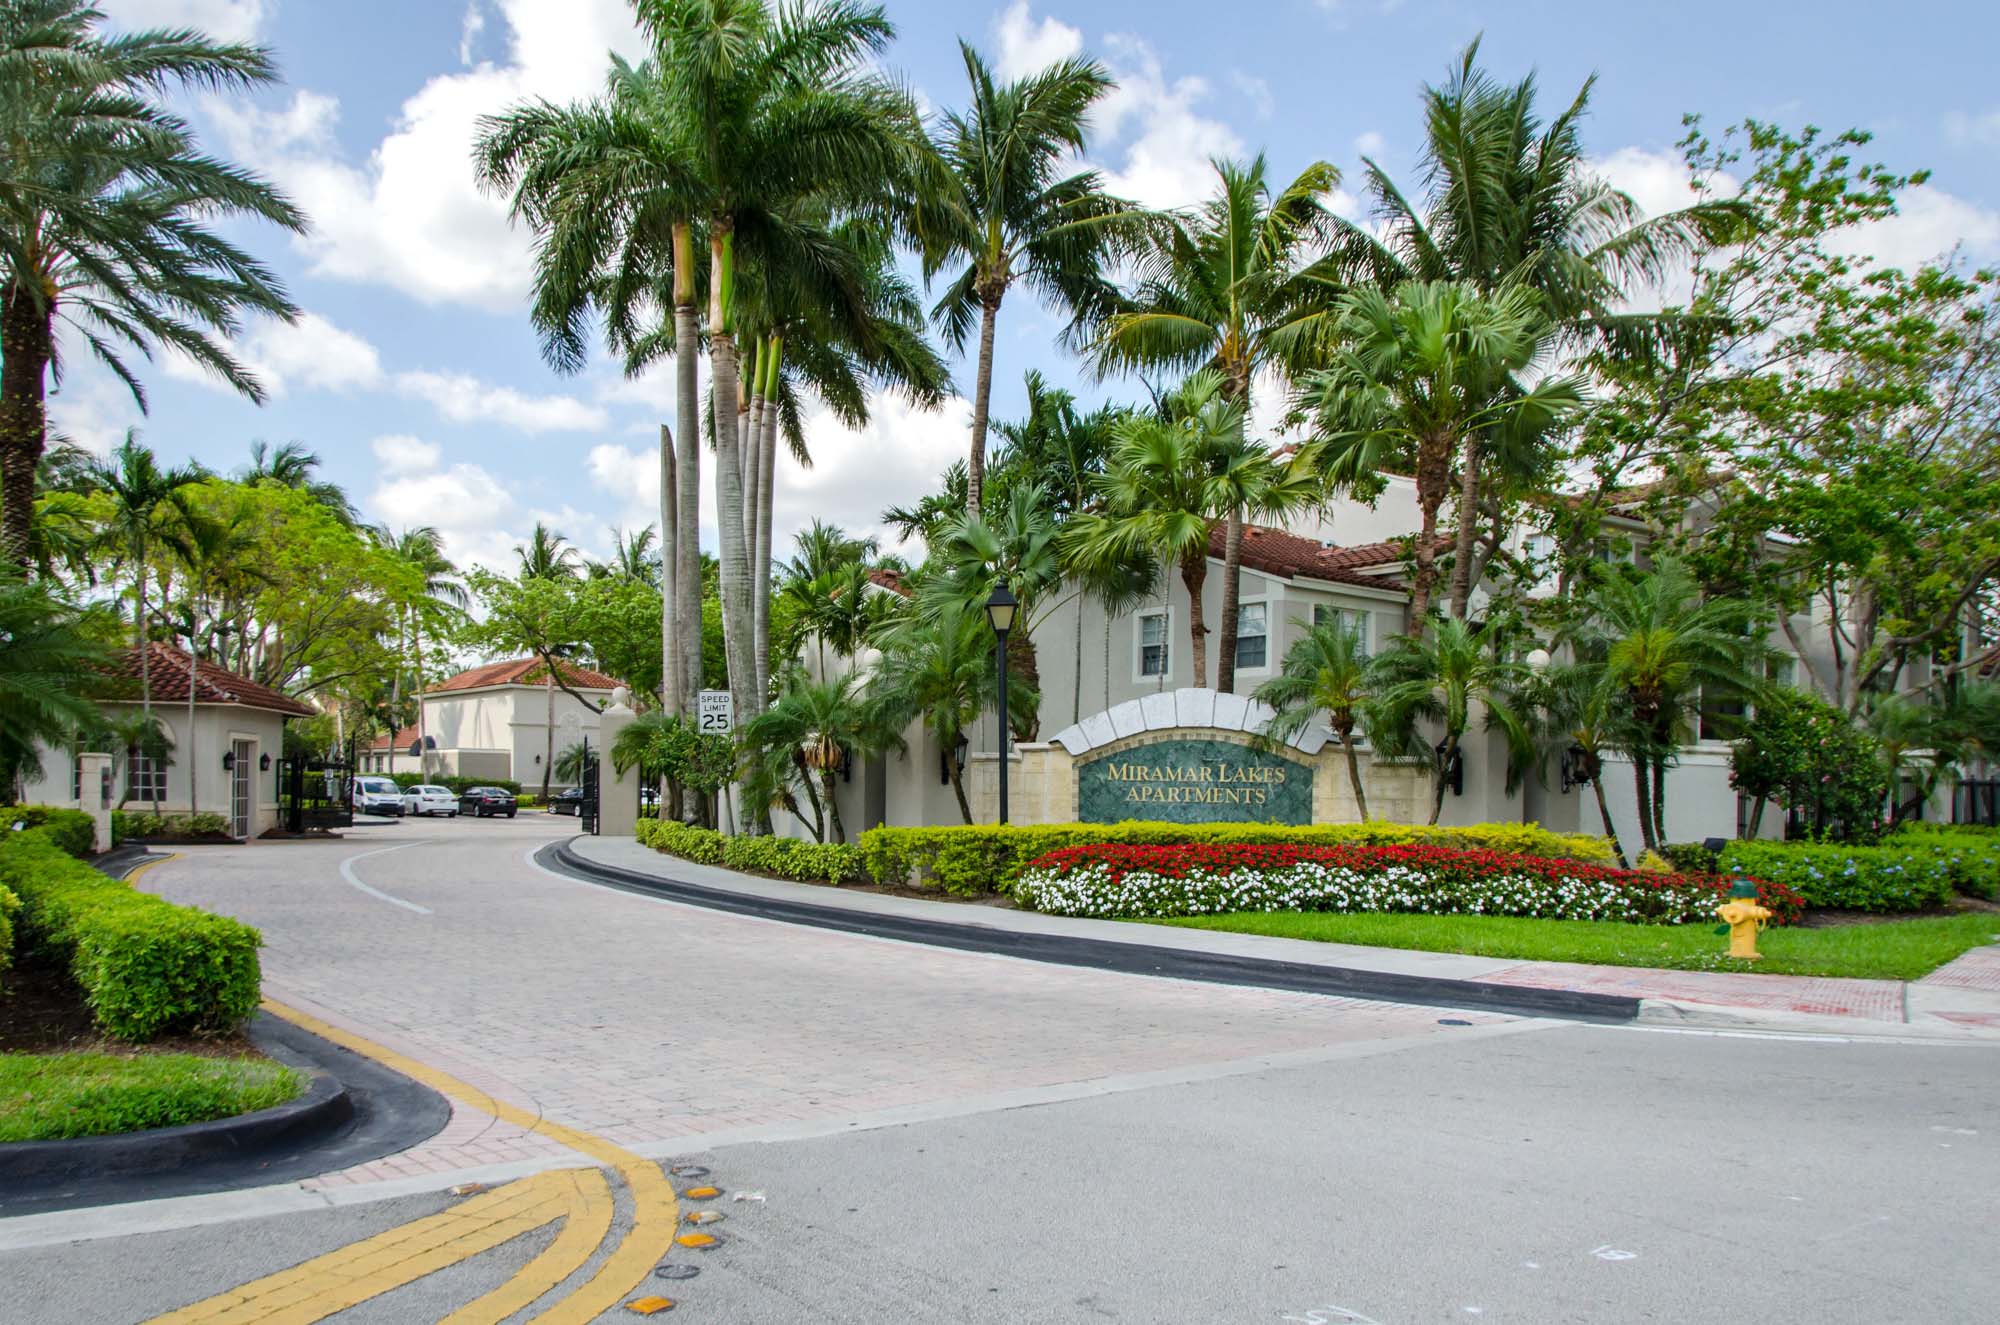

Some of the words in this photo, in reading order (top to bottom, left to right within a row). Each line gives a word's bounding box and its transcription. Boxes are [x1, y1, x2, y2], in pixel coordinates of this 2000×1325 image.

[703, 714, 728, 729] 25
[1107, 763, 1213, 782] MIRAMAR
[1219, 764, 1286, 784] LAKES
[1126, 786, 1266, 804] APARTMENTS
